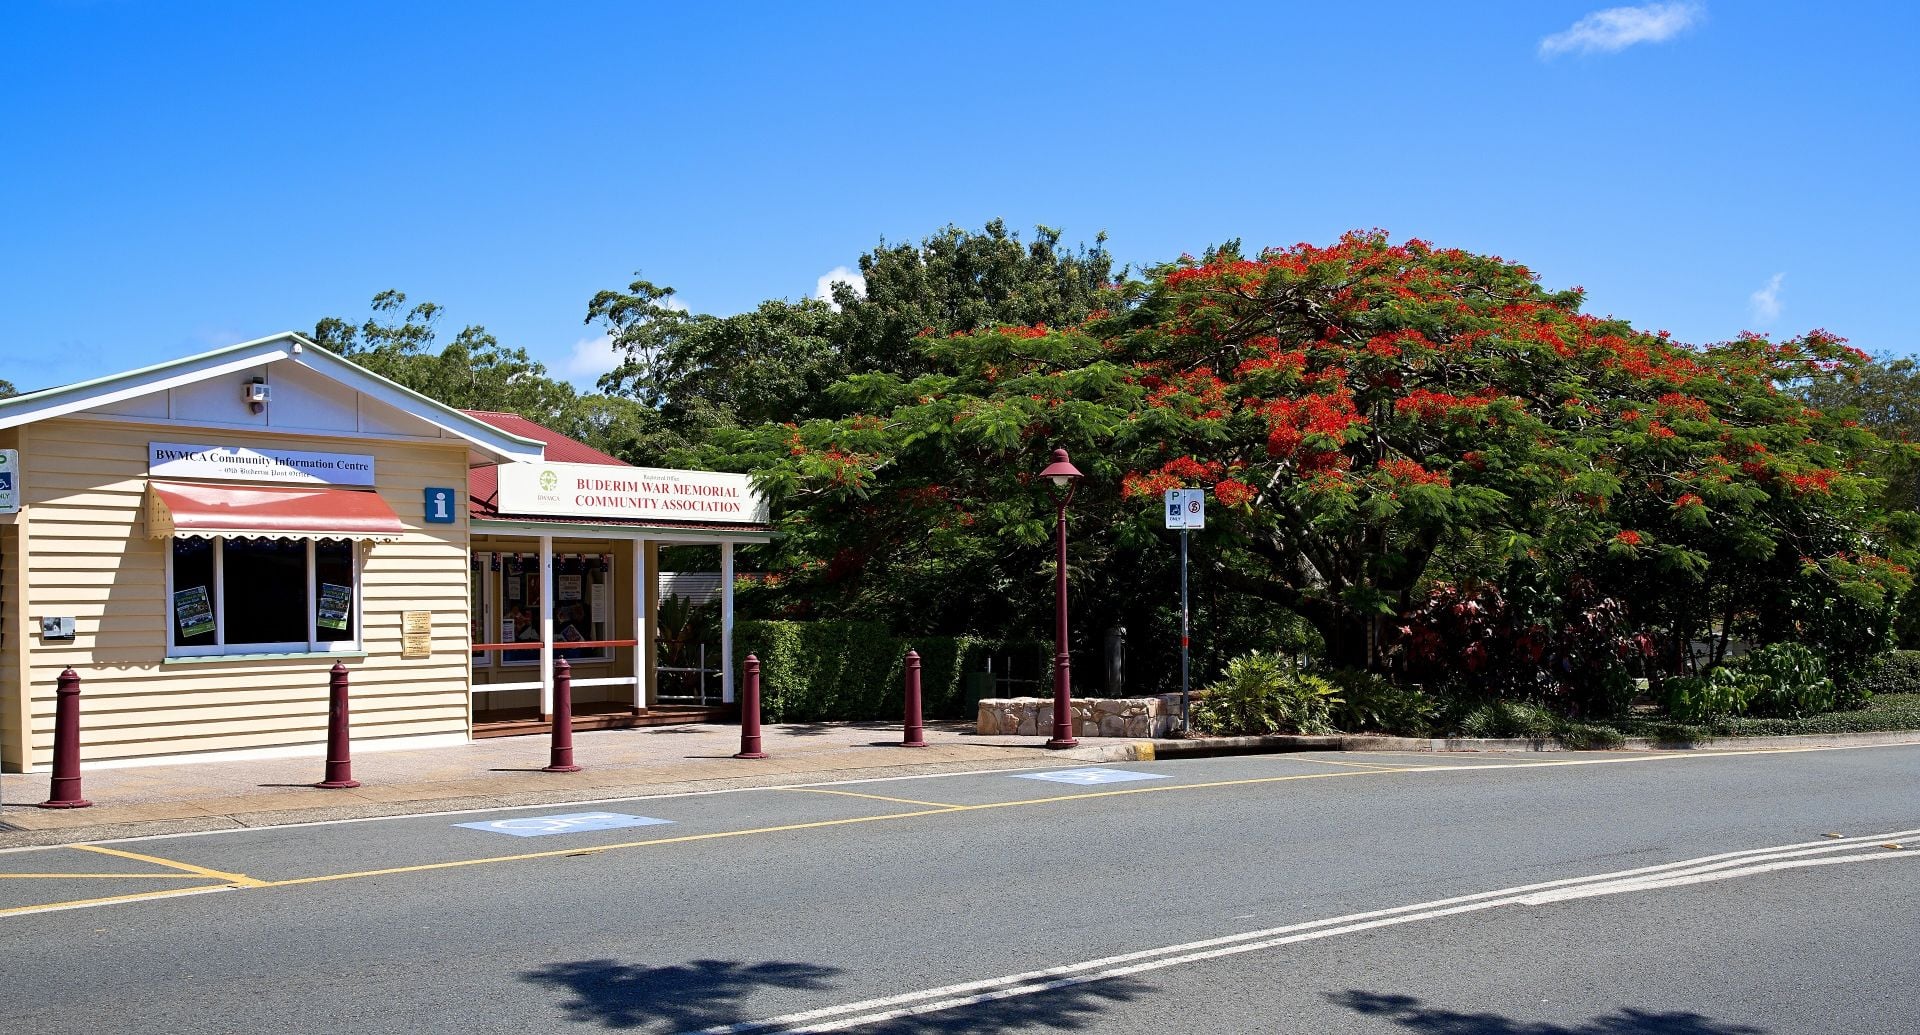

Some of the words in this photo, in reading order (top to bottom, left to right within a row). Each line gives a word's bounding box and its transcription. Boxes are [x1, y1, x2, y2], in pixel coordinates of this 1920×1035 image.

[156, 450, 207, 462] BWMCA
[210, 453, 271, 467] Community
[275, 457, 336, 469] Information
[337, 460, 369, 471] Centre
[577, 478, 638, 492] BUDERIM
[642, 482, 669, 494] WAR
[673, 484, 739, 498] MEMORIAL
[1171, 491, 1180, 501] P
[575, 495, 659, 509] COMMUNITY
[661, 499, 741, 513] ASSOCIATION
